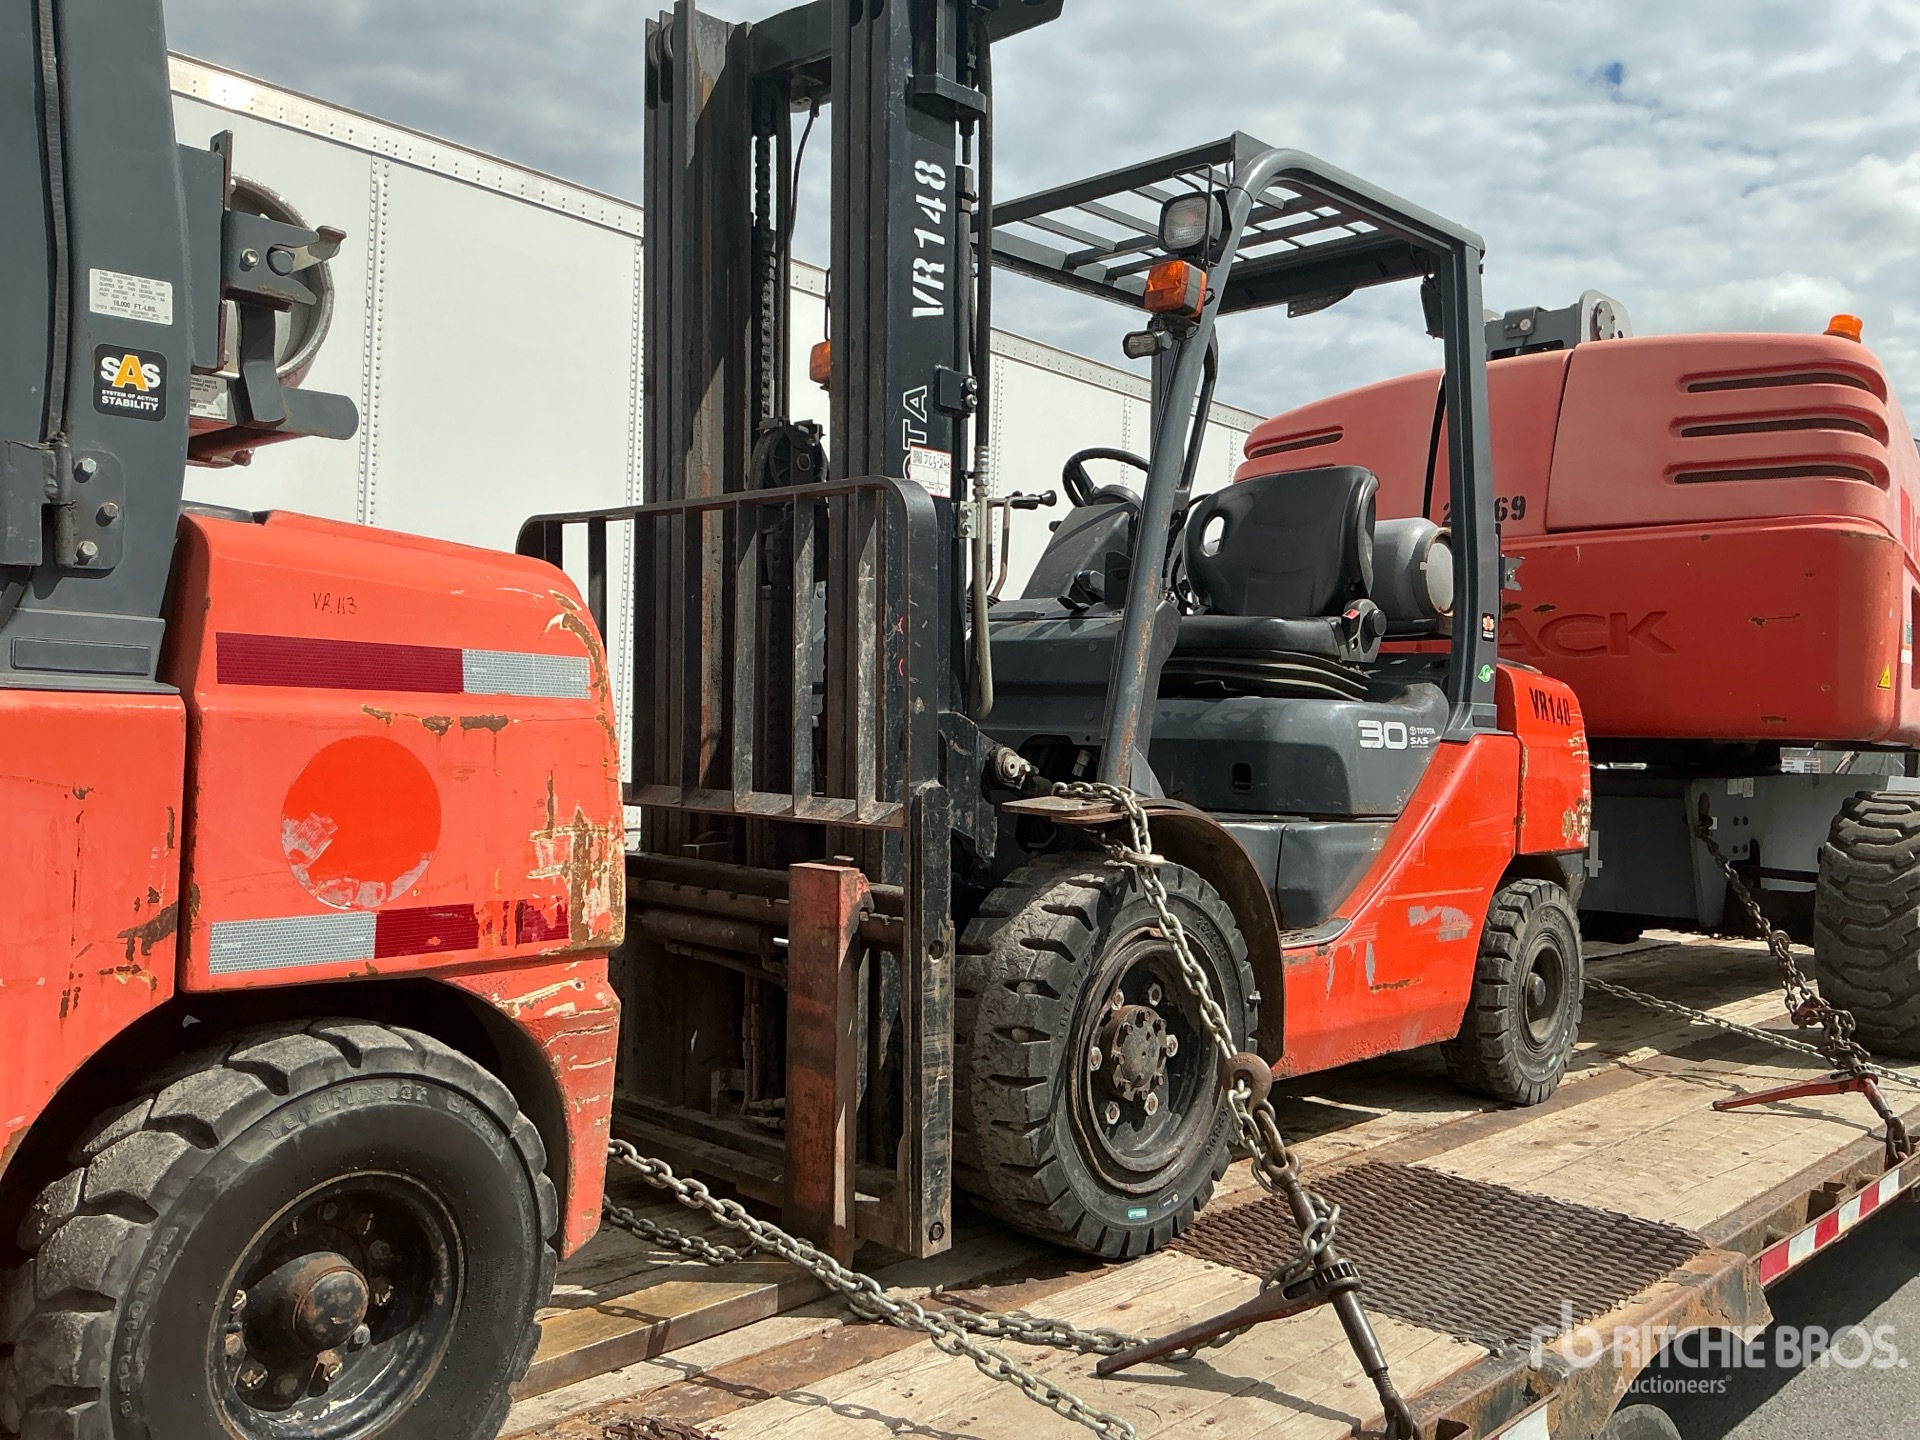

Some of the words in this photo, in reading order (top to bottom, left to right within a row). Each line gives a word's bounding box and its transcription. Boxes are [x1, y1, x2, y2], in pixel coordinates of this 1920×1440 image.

[100, 354, 161, 392] SAS
[101, 389, 127, 398] SYSTEM
[136, 394, 159, 403] ACTIVE
[101, 395, 159, 411] STABILITY
[1358, 720, 1408, 750] 30
[1417, 727, 1436, 735] TOYOTA
[1410, 737, 1429, 745] SAS
[261, 1084, 428, 1140] YardMaster
[446, 1094, 498, 1144] Ultra
